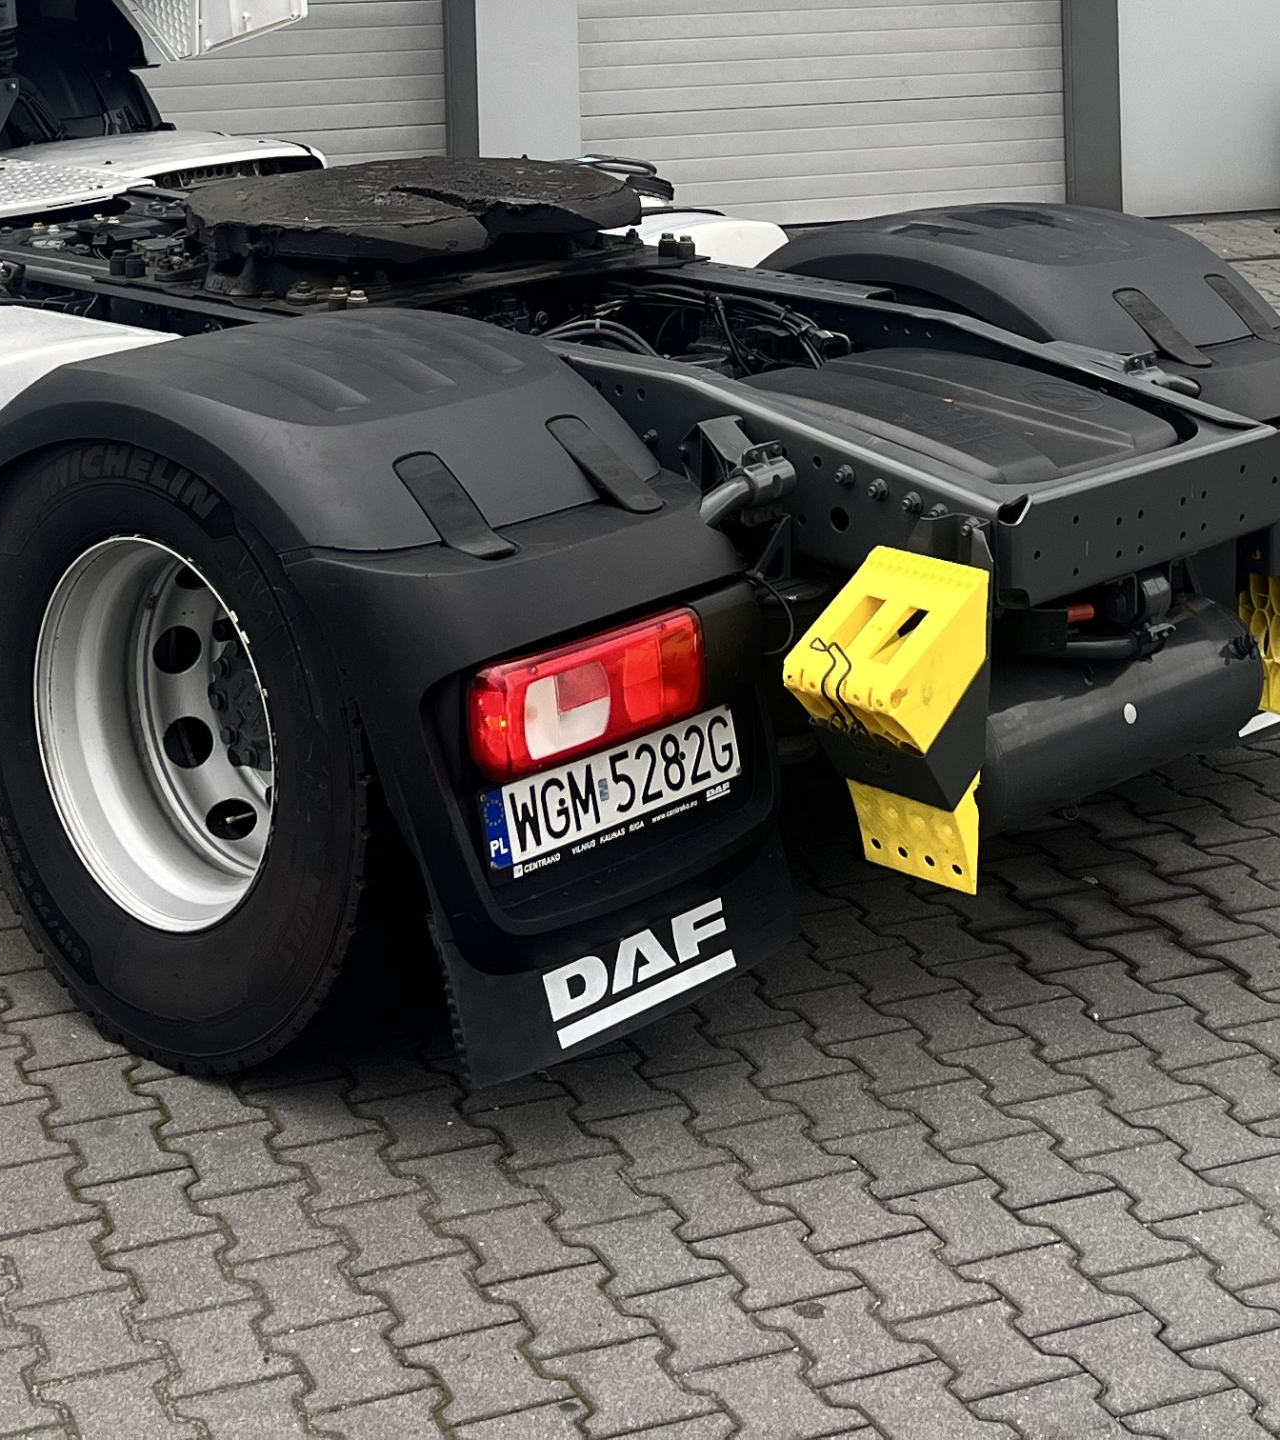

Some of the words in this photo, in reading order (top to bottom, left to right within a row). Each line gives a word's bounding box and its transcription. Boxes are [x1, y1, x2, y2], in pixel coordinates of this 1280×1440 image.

[37, 444, 220, 520] MICHELIN
[509, 763, 600, 853] WGM
[609, 715, 734, 813] 5282G
[523, 853, 561, 873] CENTRAKO
[571, 839, 596, 855] VILNIUS
[706, 781, 730, 798] DAF
[490, 837, 508, 858] PL
[542, 896, 727, 1023] DAF
